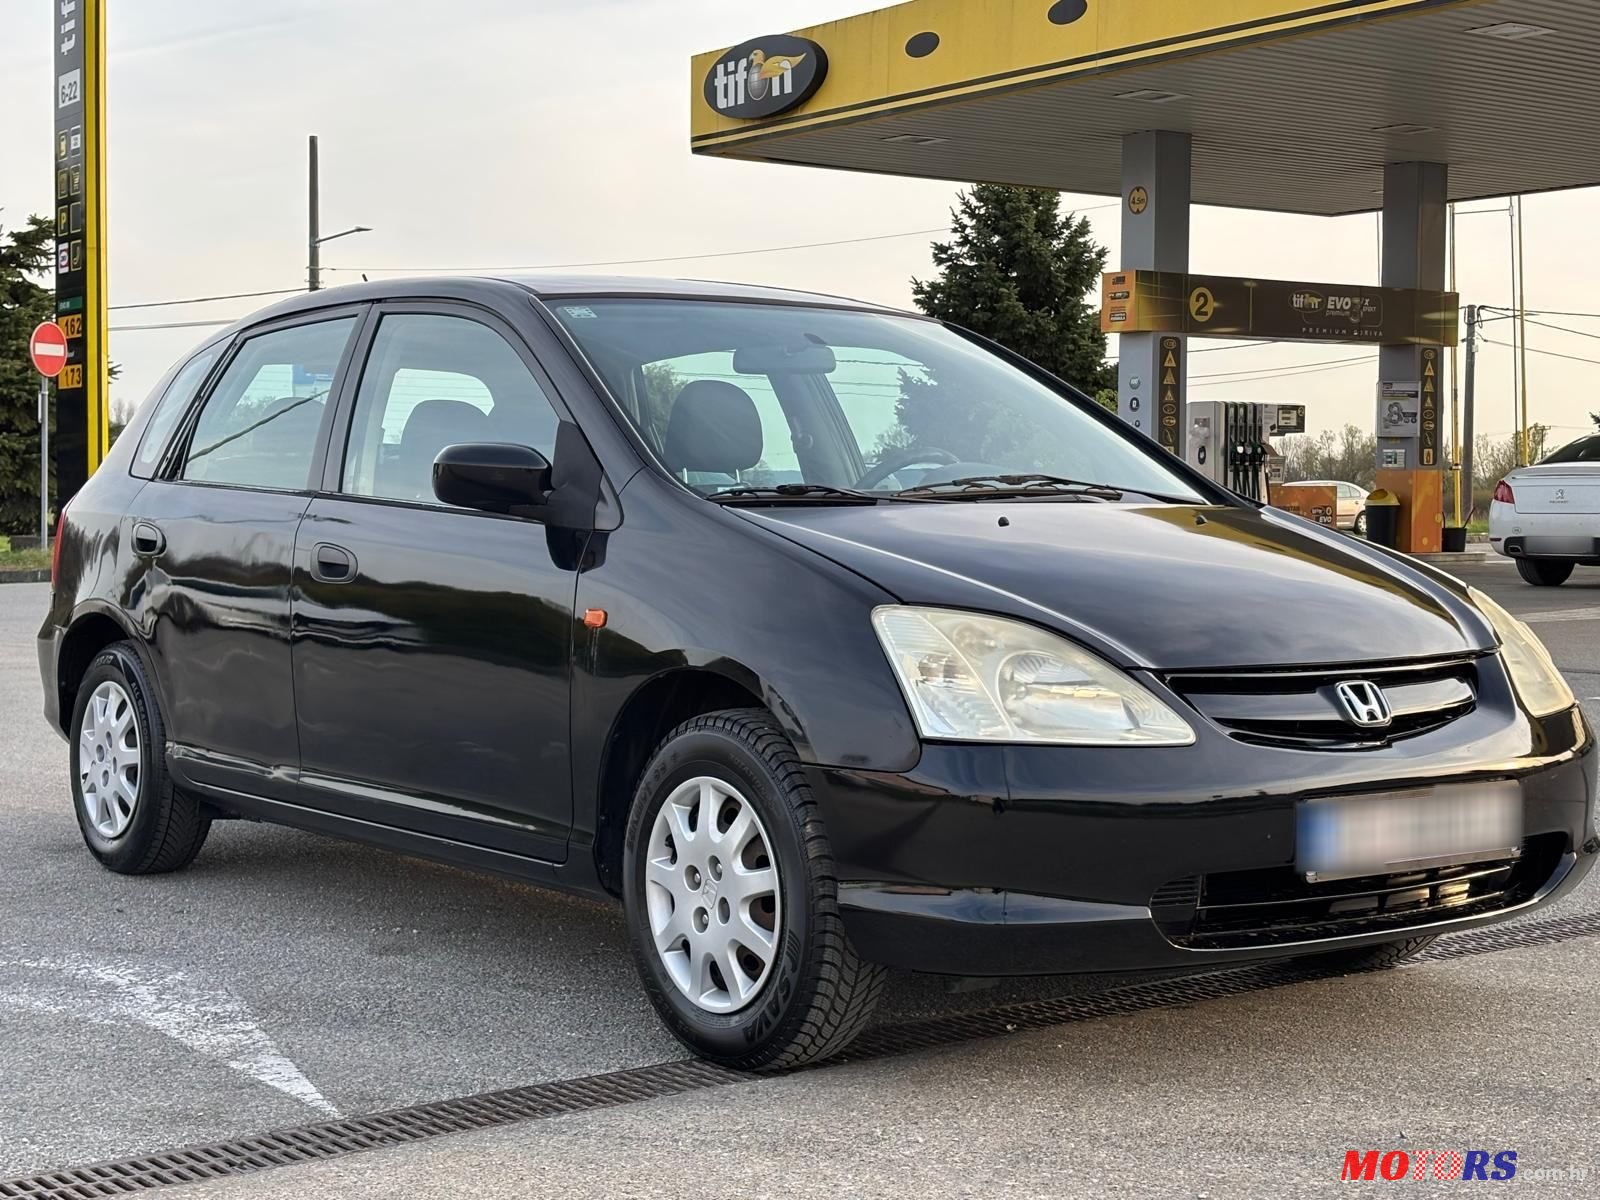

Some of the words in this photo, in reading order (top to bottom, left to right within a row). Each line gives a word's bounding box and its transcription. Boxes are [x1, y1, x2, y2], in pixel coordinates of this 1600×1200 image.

[61, 81, 77, 103] 6-22
[714, 56, 793, 108] tifon
[1195, 292, 1208, 316] 2
[1327, 296, 1351, 310] EVO
[1302, 327, 1347, 335] PREMIUM
